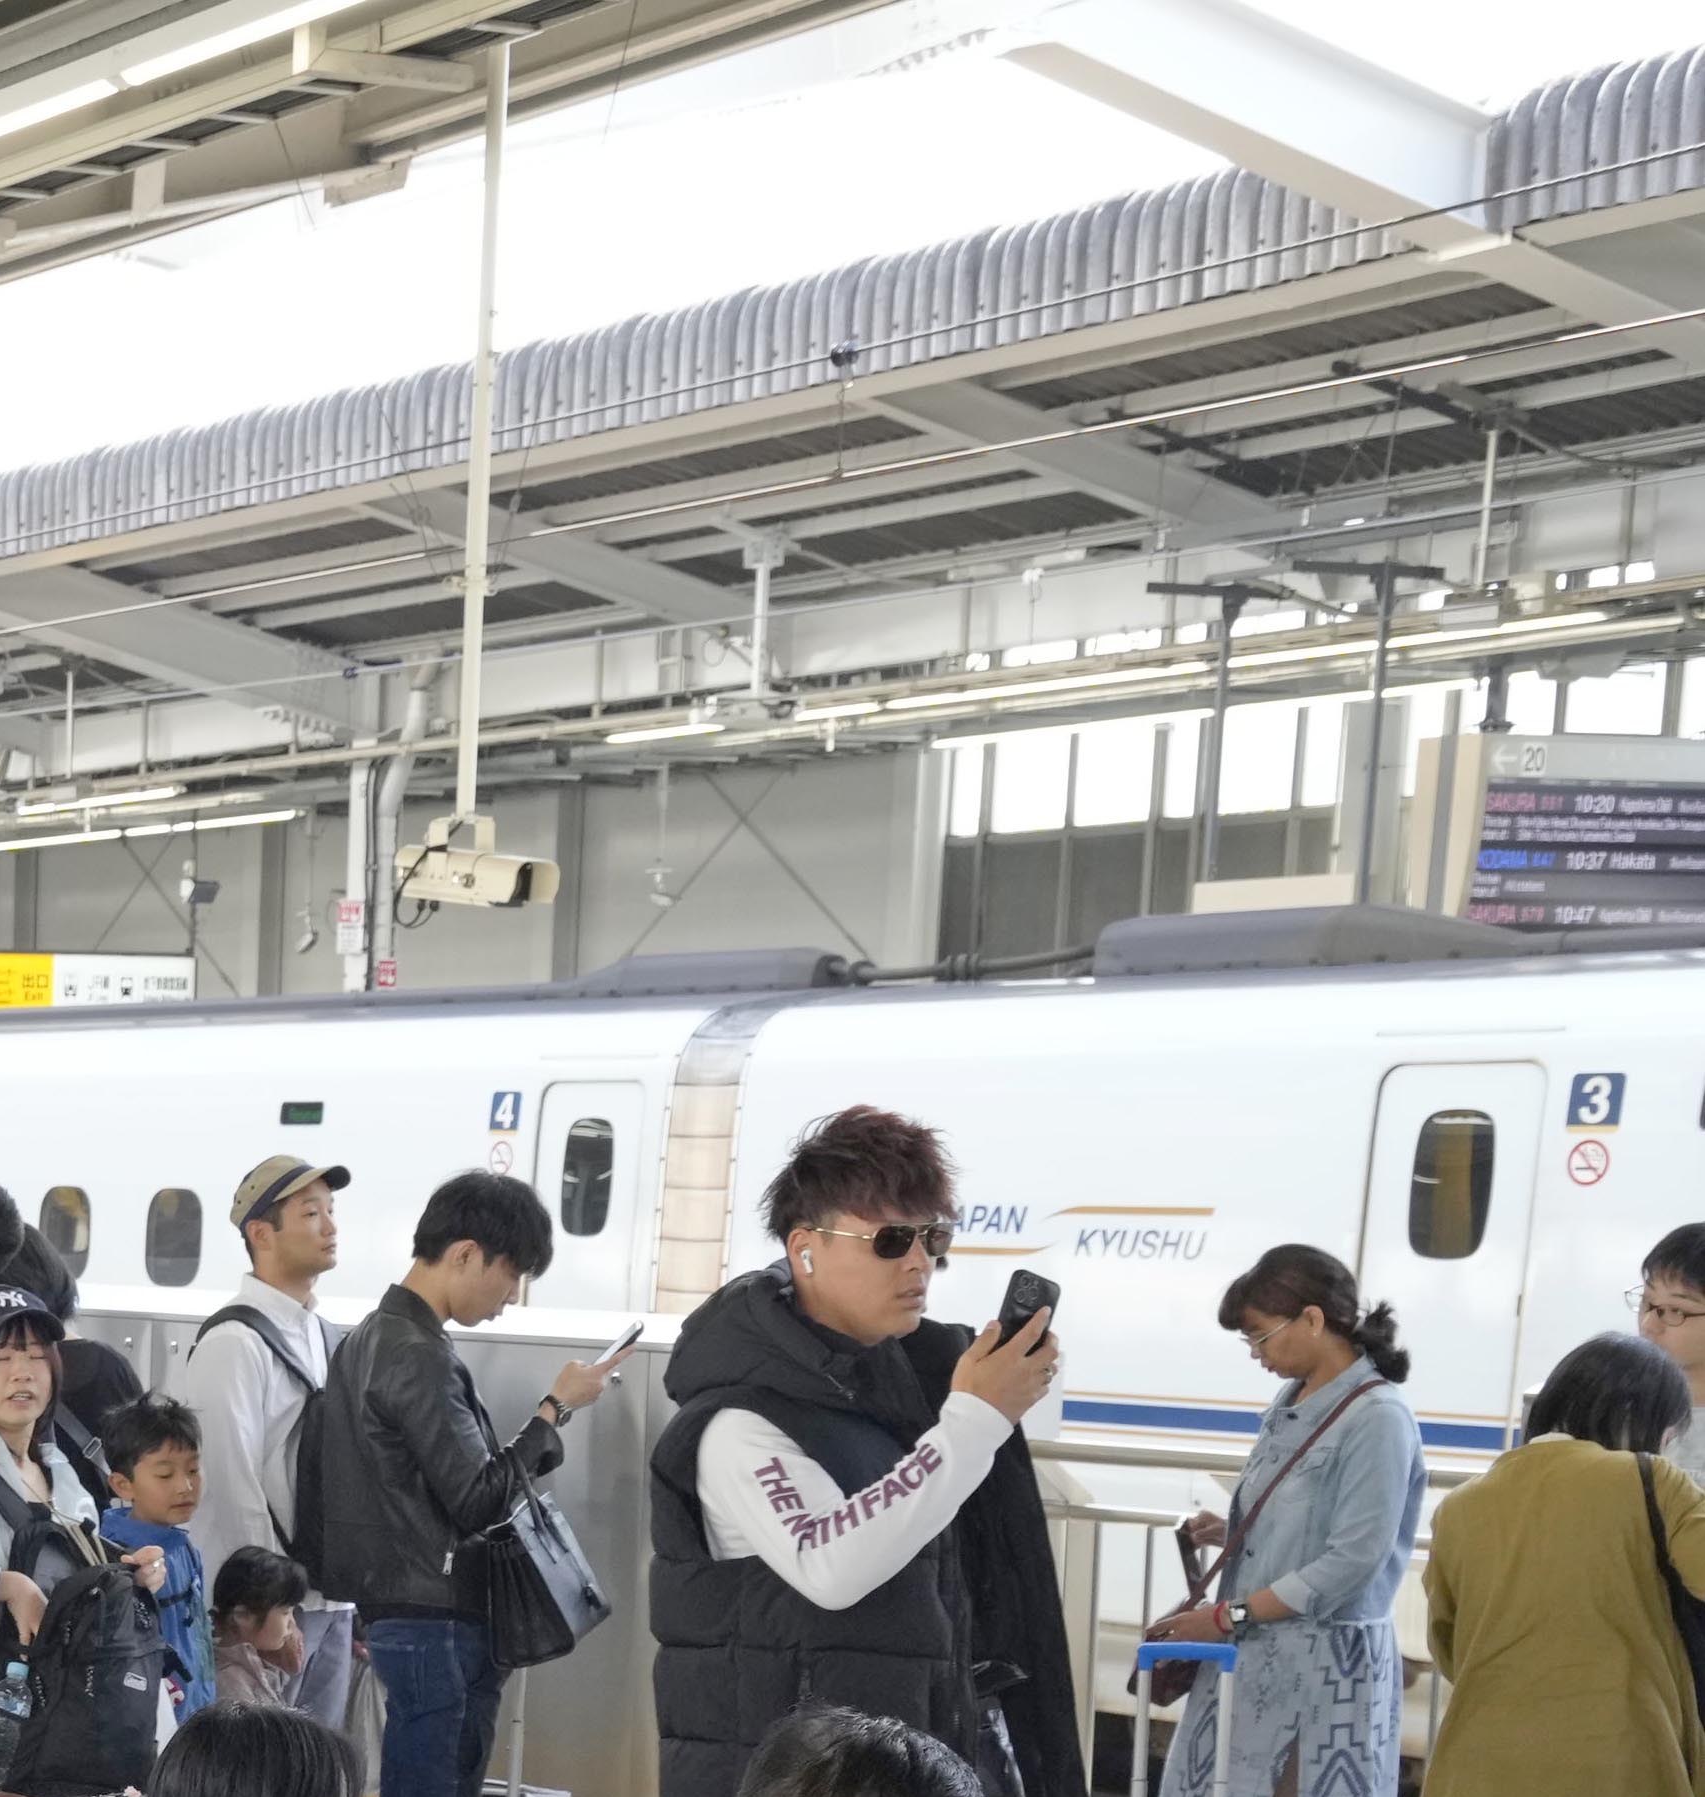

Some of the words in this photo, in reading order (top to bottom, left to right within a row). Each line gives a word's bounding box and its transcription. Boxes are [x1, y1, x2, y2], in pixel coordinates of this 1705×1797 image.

[1524, 747, 1546, 772] 20
[494, 1092, 515, 1131] 4
[1576, 1075, 1612, 1126] 3
[952, 1205, 1028, 1236] APAN
[1074, 1229, 1208, 1262] KYUSHU
[754, 1457, 805, 1514] THE
[859, 1443, 943, 1521] FACE
